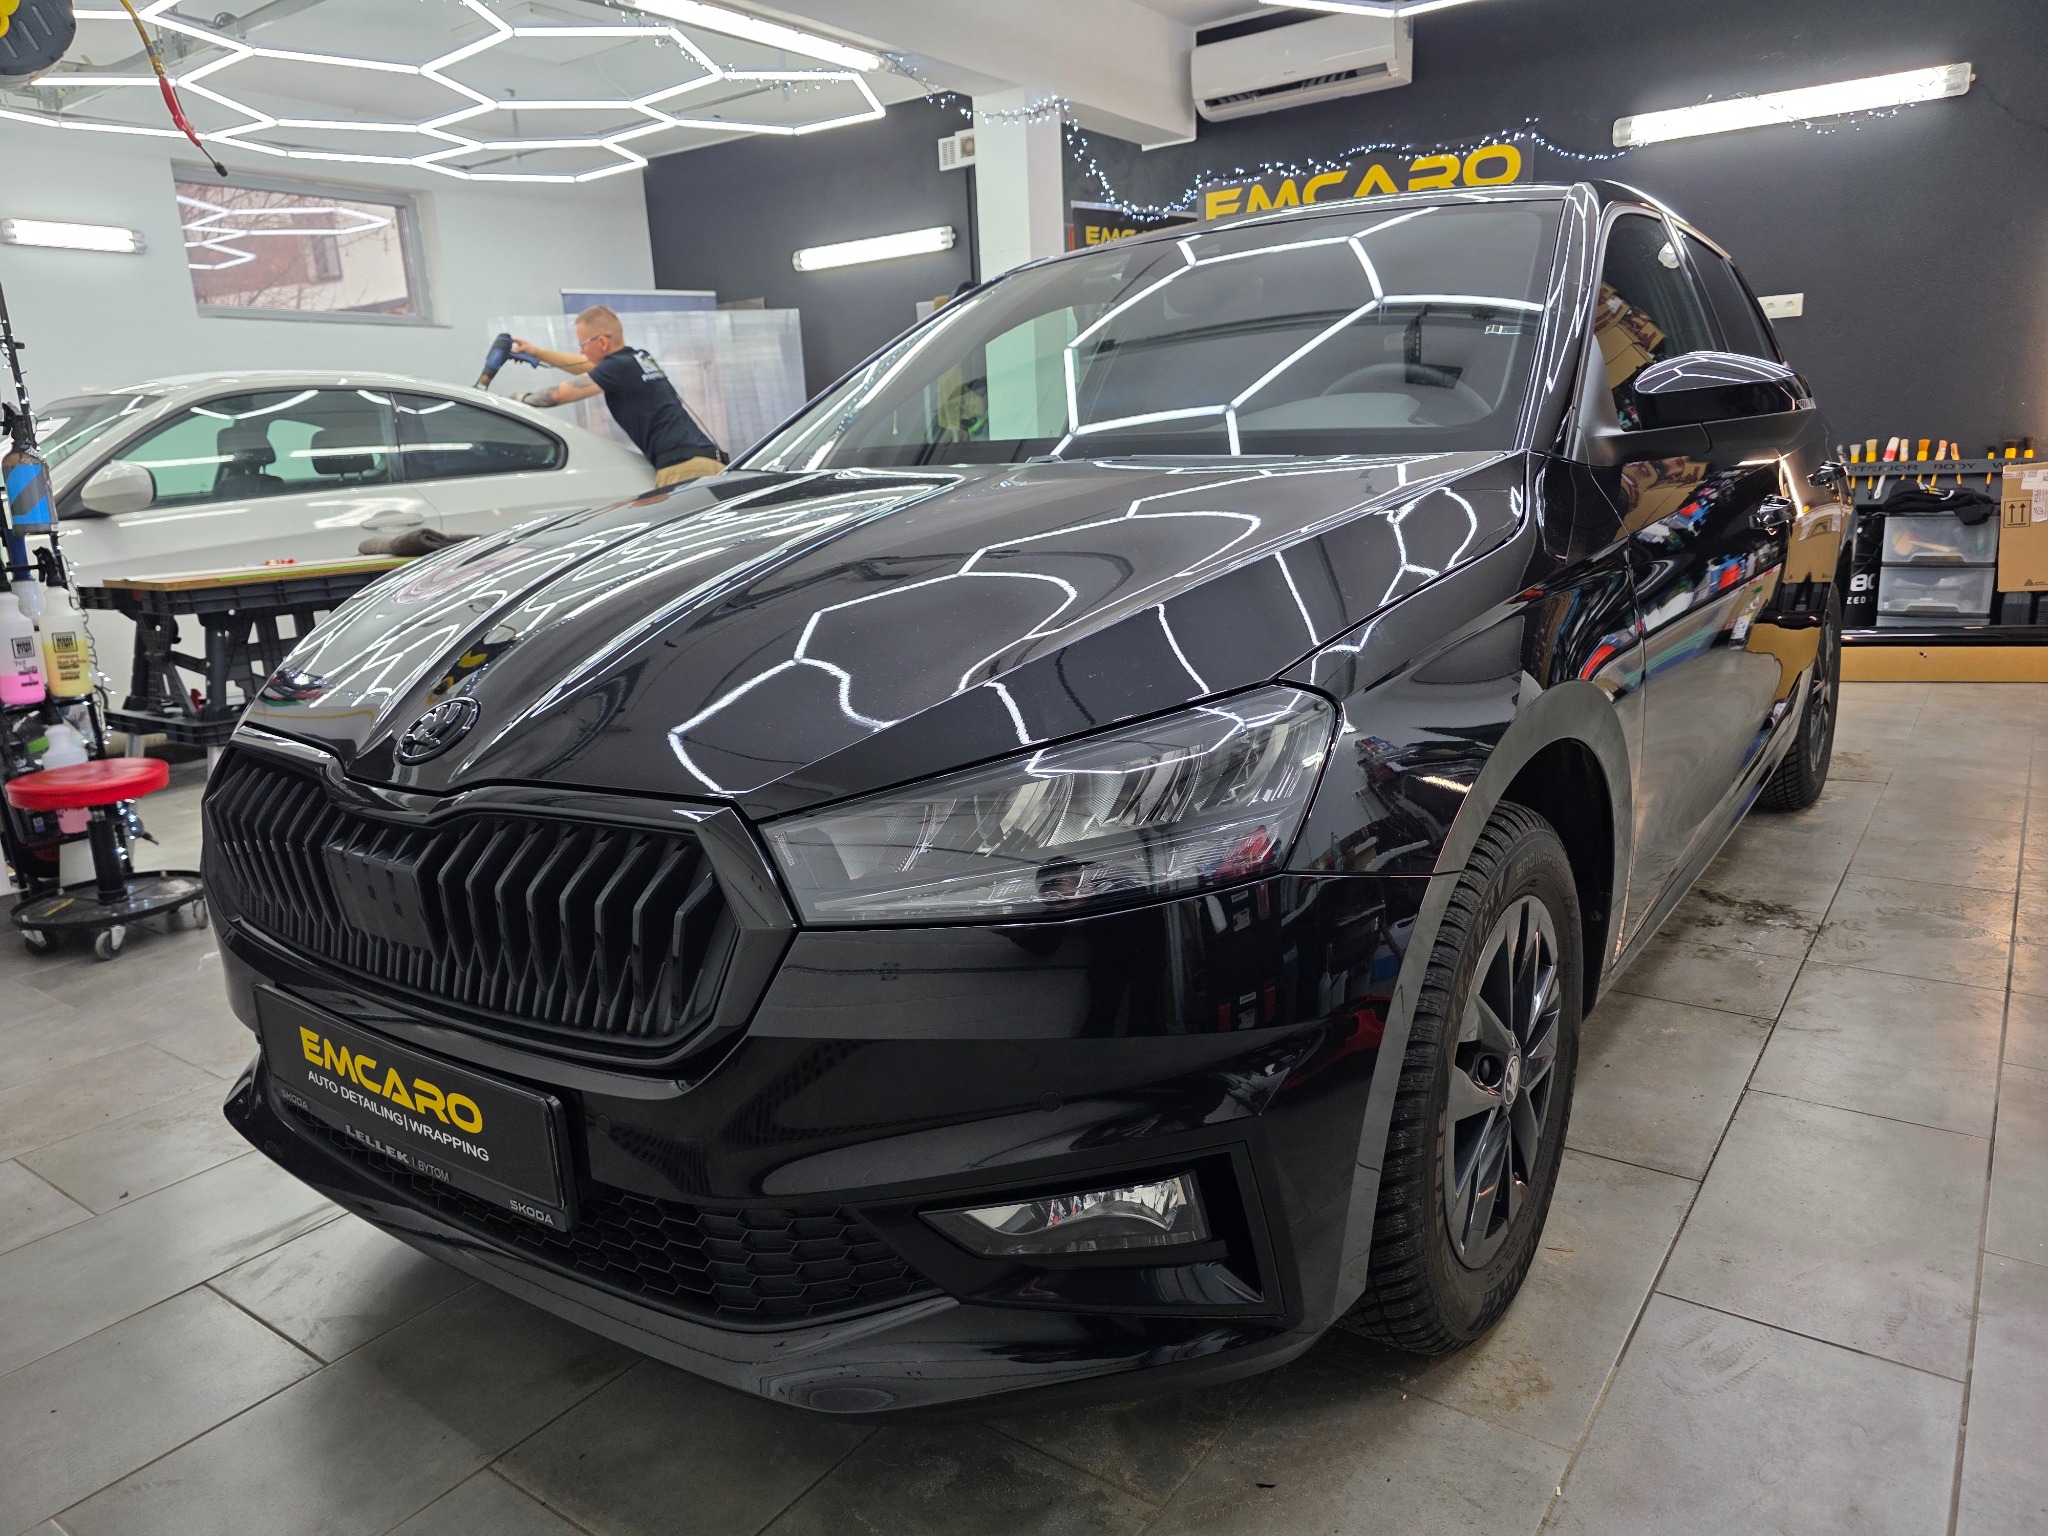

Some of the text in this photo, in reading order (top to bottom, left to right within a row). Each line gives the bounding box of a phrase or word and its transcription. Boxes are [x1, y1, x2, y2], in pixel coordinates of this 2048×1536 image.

[1206, 144, 1522, 220] EMCARO
[1934, 462, 1976, 471] BODY
[299, 1025, 483, 1134] EMCARO
[308, 1070, 338, 1094] AUTO
[345, 1124, 451, 1183] LELLEK BYTOM
